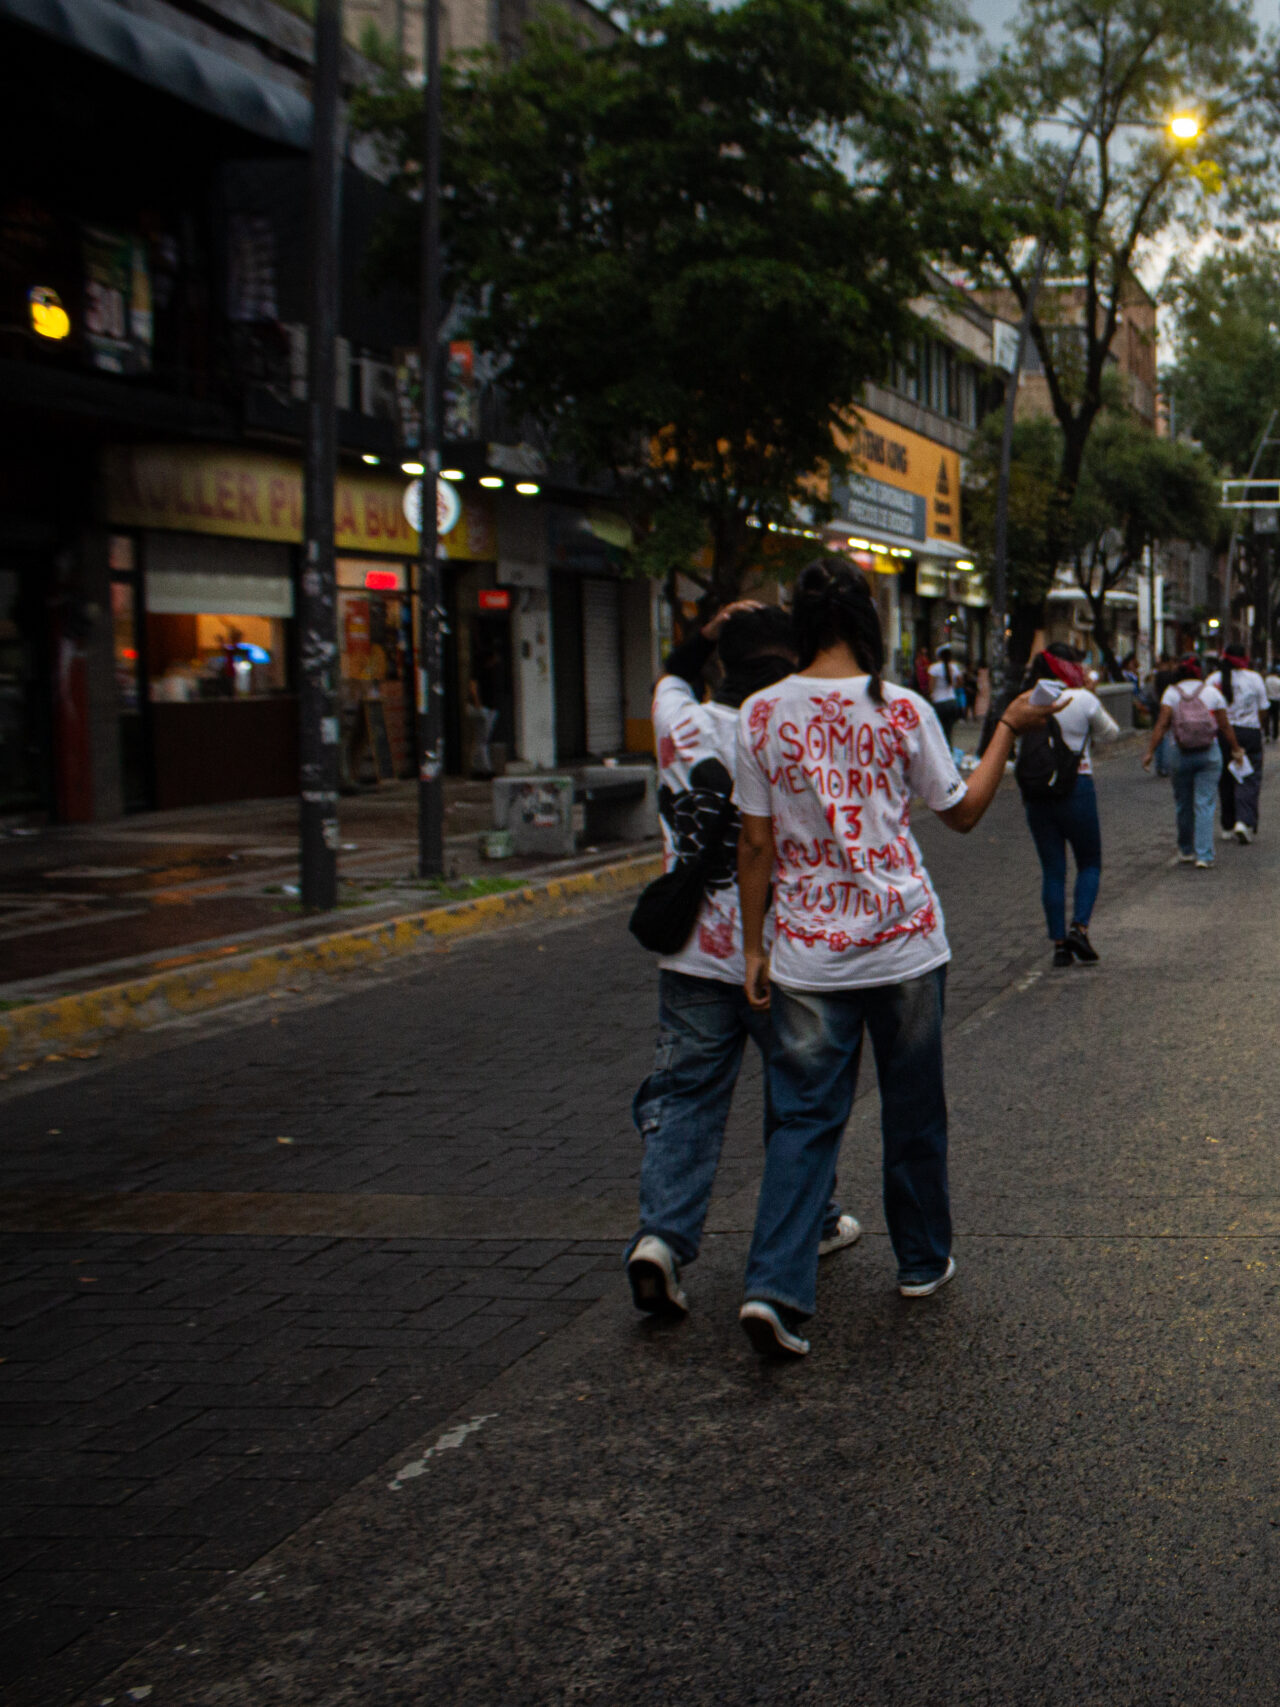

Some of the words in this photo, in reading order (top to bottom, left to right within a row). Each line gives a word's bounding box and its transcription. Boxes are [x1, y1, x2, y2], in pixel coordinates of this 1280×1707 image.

[778, 721, 895, 768] SOMOS
[765, 764, 892, 800] MEMORIA
[786, 874, 906, 923] JUSTICIA
